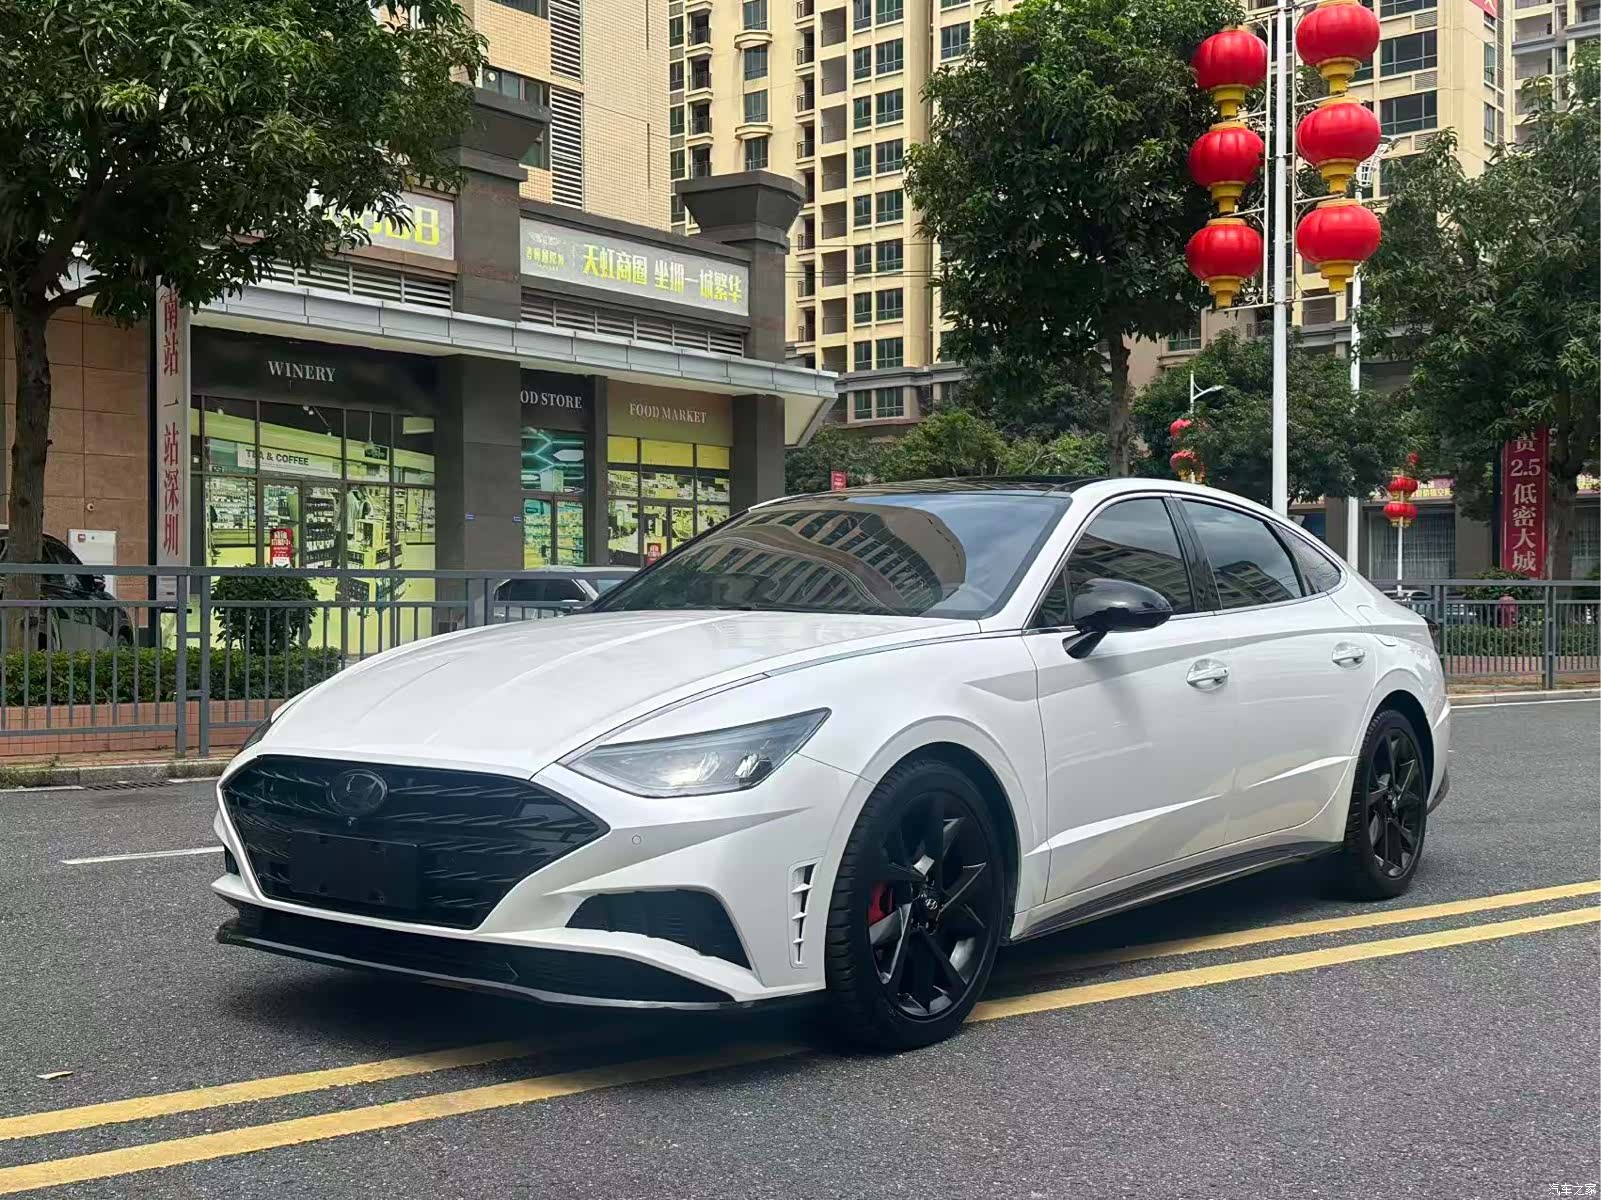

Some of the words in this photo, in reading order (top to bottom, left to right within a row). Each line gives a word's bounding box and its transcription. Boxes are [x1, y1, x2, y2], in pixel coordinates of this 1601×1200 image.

[582, 243, 648, 286] 天虹商圈
[267, 360, 336, 382] WINERY
[541, 392, 582, 409] STORE
[629, 403, 660, 418] FOOD
[661, 407, 707, 424] MARKET
[275, 453, 310, 466] COFFEE
